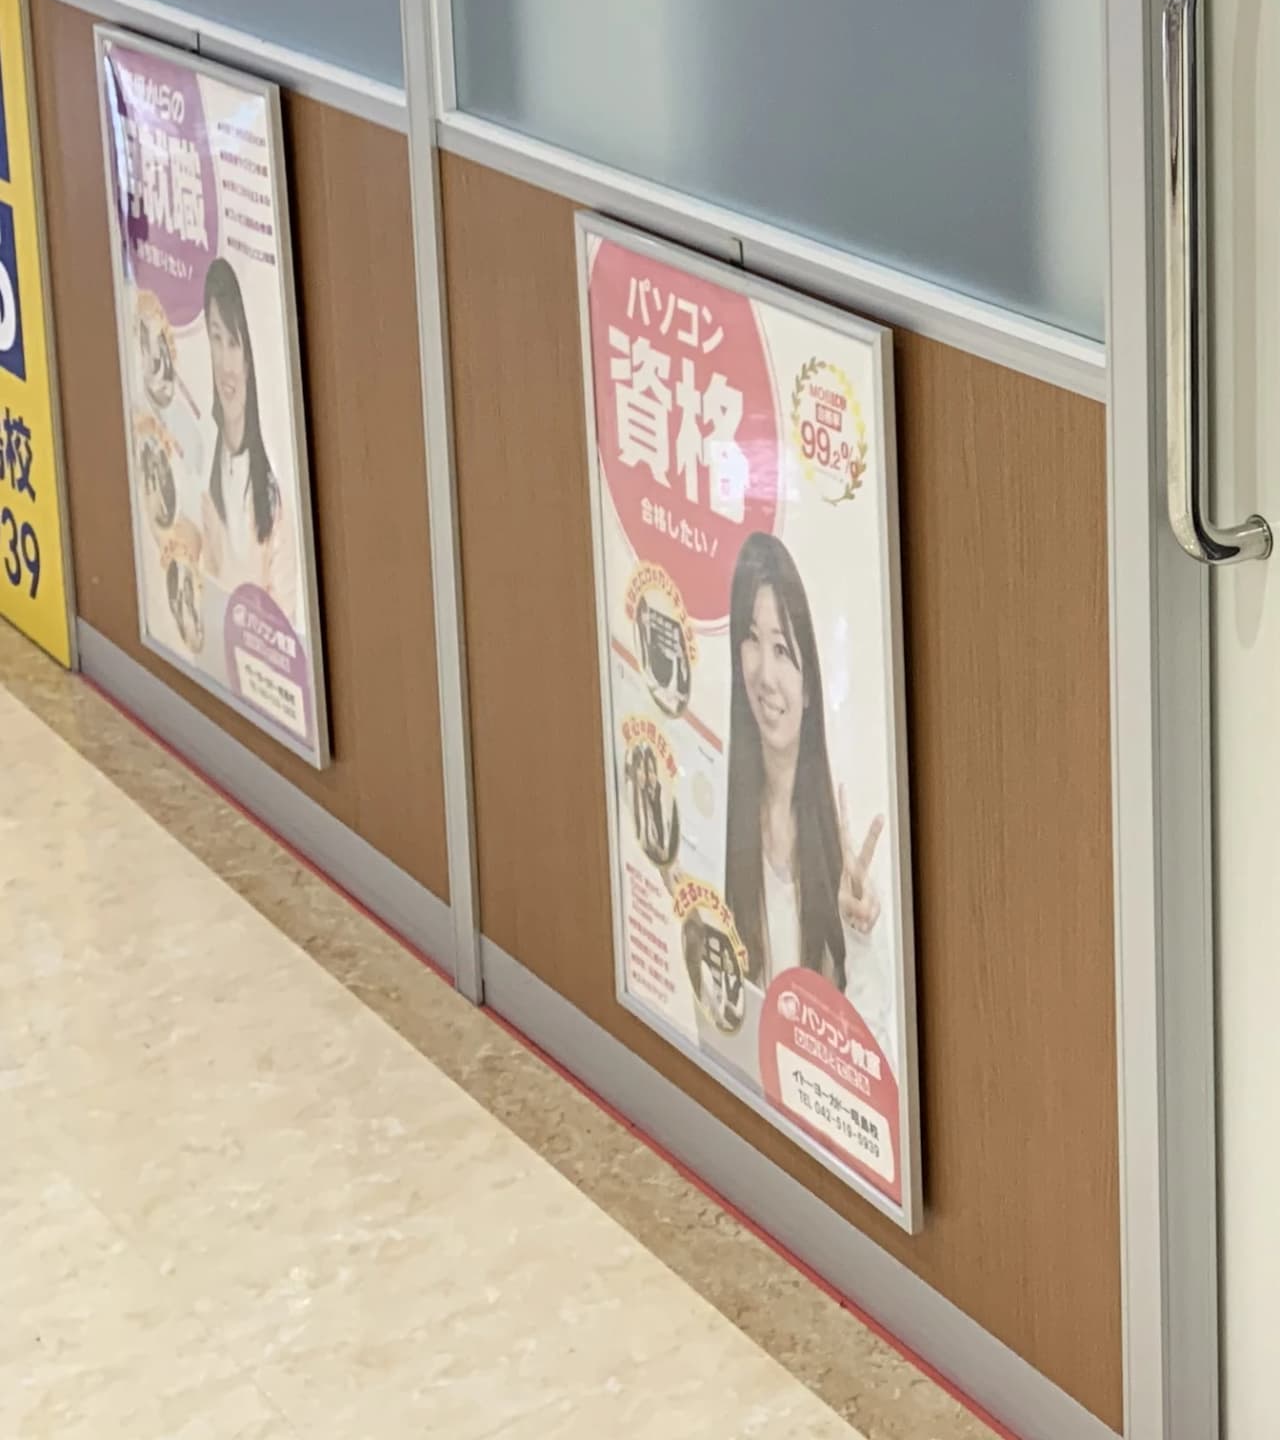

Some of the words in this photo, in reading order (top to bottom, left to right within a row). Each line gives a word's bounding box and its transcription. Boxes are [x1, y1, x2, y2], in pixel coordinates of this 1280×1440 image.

[626, 276, 726, 356] パソコン
[608, 325, 751, 525] 資格
[640, 496, 720, 560] 合格したい!
